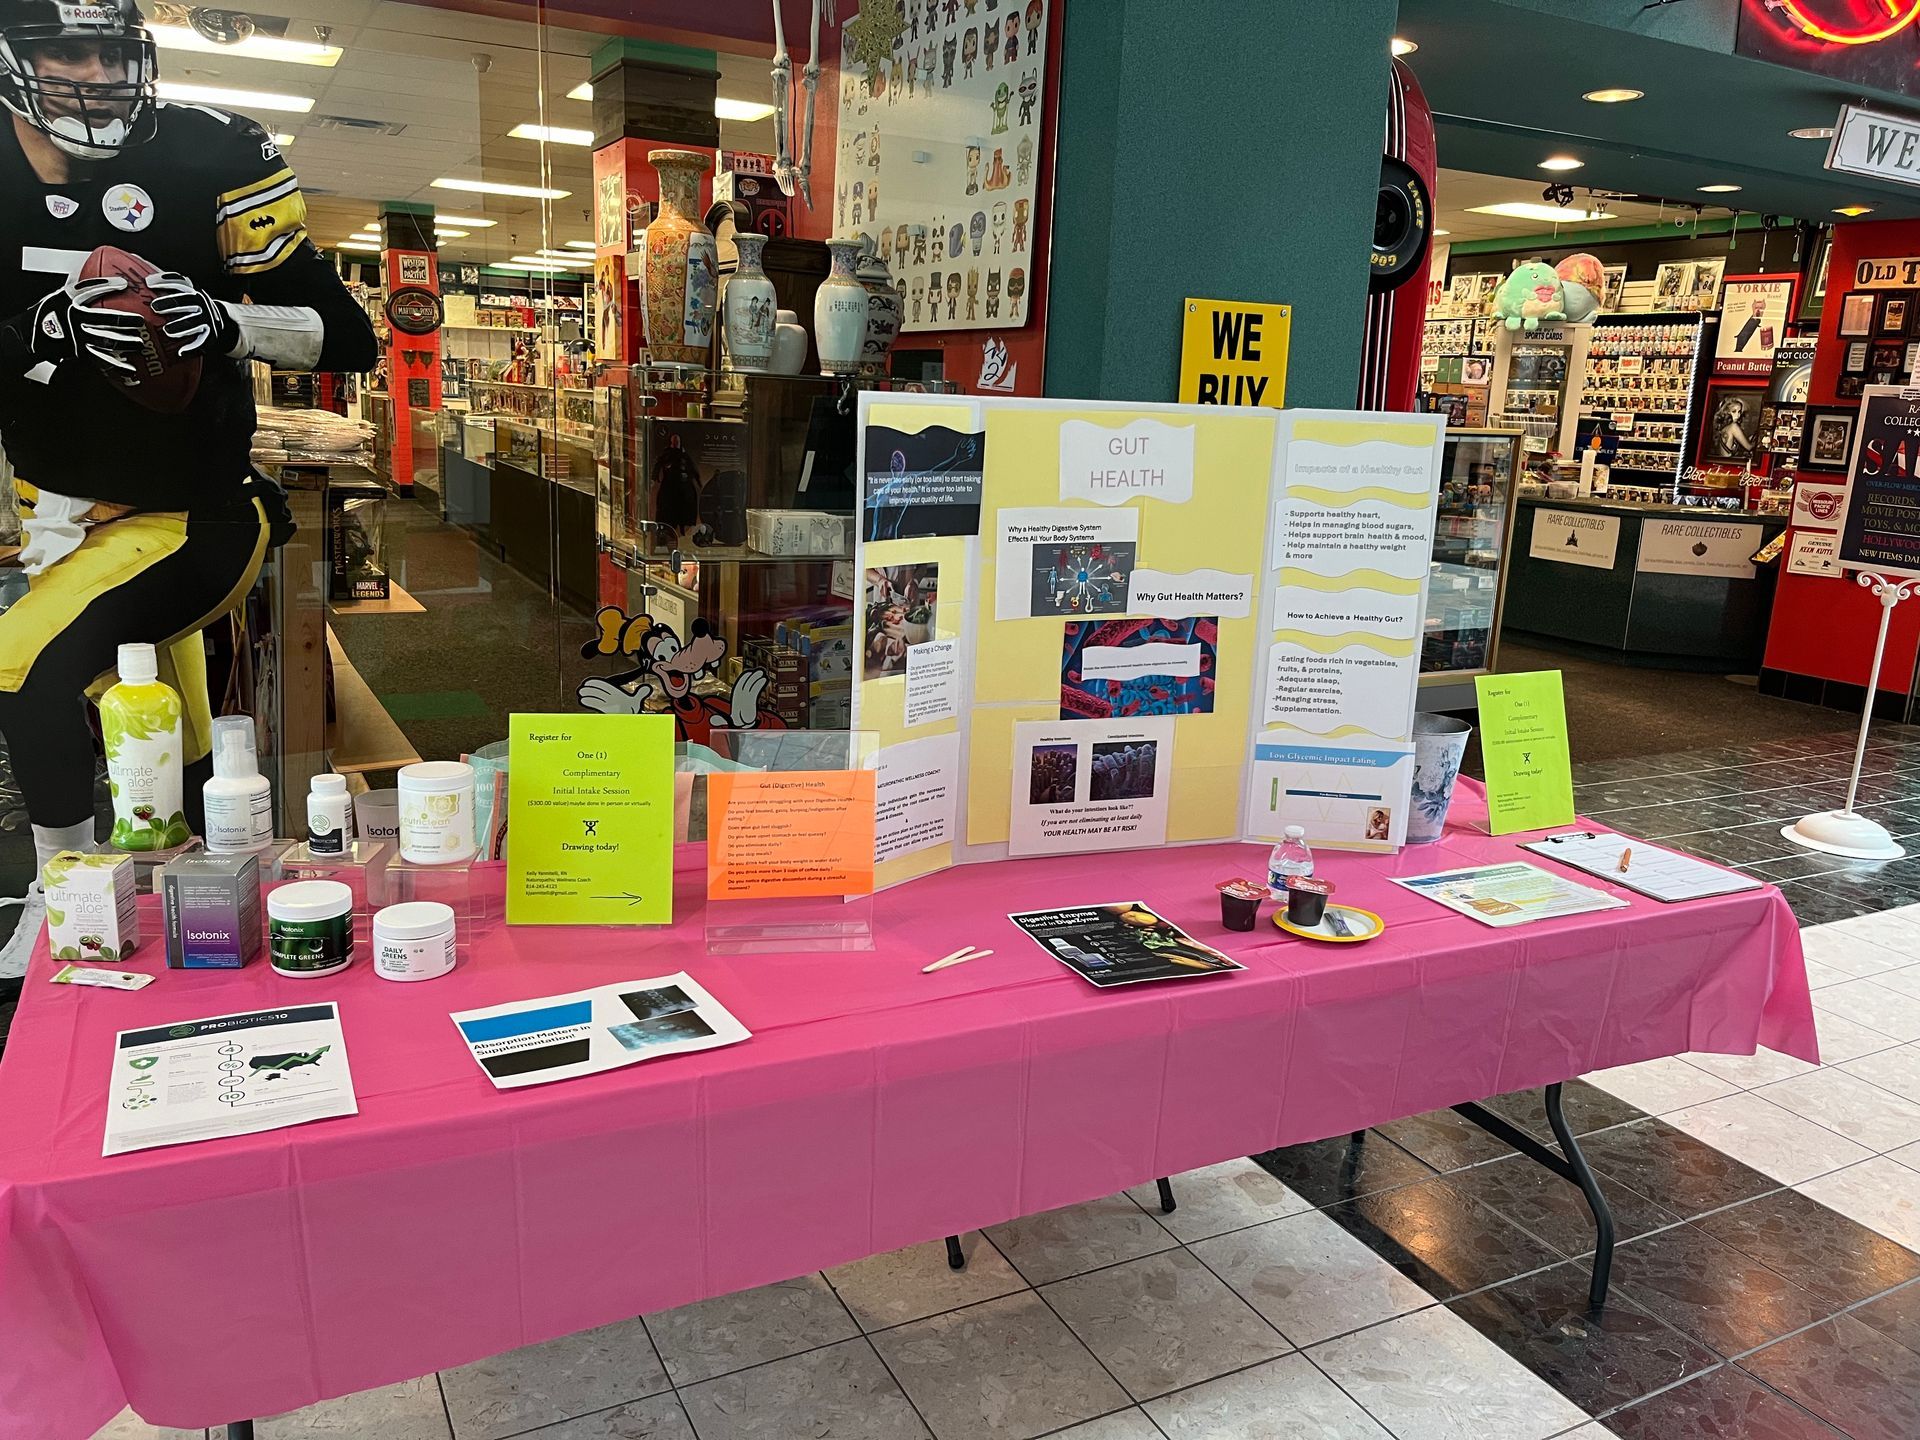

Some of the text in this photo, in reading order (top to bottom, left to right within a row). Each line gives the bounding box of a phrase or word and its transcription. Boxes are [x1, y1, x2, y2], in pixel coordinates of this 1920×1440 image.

[74, 8, 107, 18] Ridde
[1866, 124, 1920, 172] WE
[1737, 284, 1781, 293] YORKIE
[1212, 311, 1263, 361] WE
[1717, 361, 1745, 371] Peanut
[1198, 373, 1268, 406] BUY
[1108, 437, 1149, 455] GUT
[1863, 440, 1920, 478] SA
[1295, 464, 1423, 476] Impacts of Healthy Gut
[1682, 466, 1706, 481] Blac
[1090, 469, 1164, 488] HEALTH
[1868, 493, 1917, 506] RECORDS,
[1290, 510, 1325, 518] Supports
[1861, 505, 1894, 517] MOVIE
[1547, 514, 1606, 531] RARE COLLECTIBLES
[1863, 518, 1890, 530] TOYS,
[1028, 525, 1050, 533] Healthy
[1052, 524, 1078, 532] Digestive
[1661, 524, 1742, 540] RARE COLLECTIBLES
[332, 506, 344, 575] MASTERWORKS
[1859, 548, 1877, 558] NEW
[1878, 551, 1903, 561] ITEMS
[356, 581, 378, 590] MARVEL
[352, 588, 385, 598] LEGENDS
[1136, 592, 1243, 602] Why Gut Health Matters?
[934, 644, 952, 652] Change
[1272, 696, 1311, 704] -Managing
[1272, 705, 1341, 715] -Supplementation.
[529, 734, 559, 743] Register
[596, 751, 607, 760] (1)
[1287, 753, 1322, 762] Glycemic
[1324, 755, 1350, 764] Impact
[1352, 757, 1376, 766] Eating
[110, 766, 152, 777] ultimate
[563, 769, 621, 779] Complimentary
[562, 843, 619, 853] Drawing today!
[51, 891, 102, 902] ultimate
[1019, 915, 1058, 923] Digestive
[281, 925, 304, 933] Isotonix
[187, 930, 230, 940] Isotonix
[272, 950, 297, 960] COMPLETE
[382, 951, 408, 960] GREENS
[200, 1013, 288, 1030] PROBIOTICS10
[474, 1033, 534, 1050] Absorption
[537, 1026, 578, 1038] Matters
[476, 1034, 576, 1056] Supplementation!
